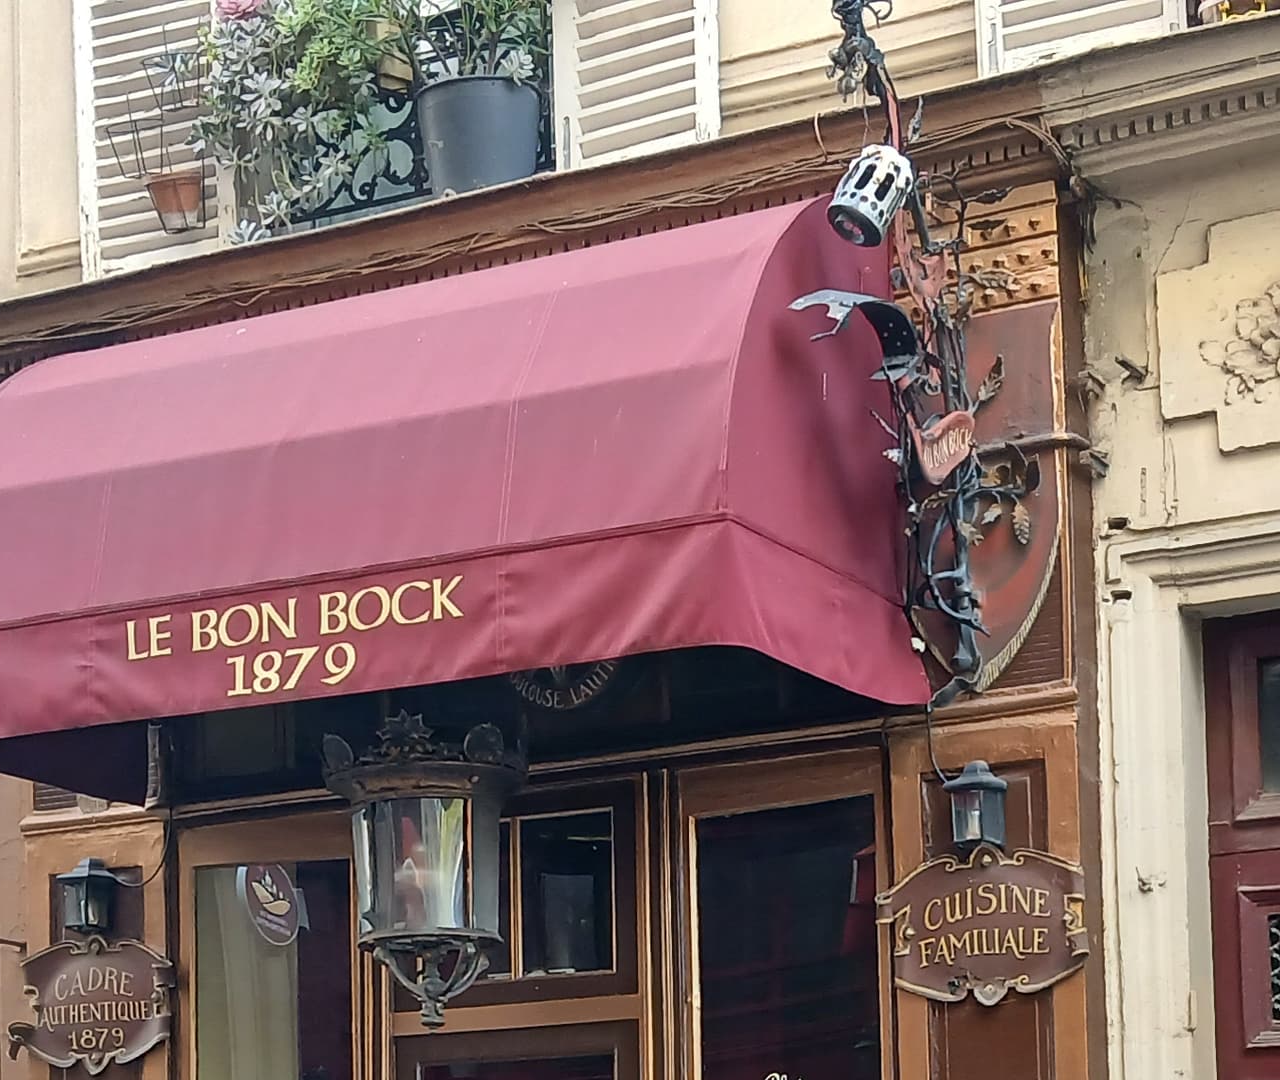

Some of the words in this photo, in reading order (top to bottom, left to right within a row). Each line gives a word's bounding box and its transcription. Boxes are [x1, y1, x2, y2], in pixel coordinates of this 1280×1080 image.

[126, 613, 172, 661] LE
[191, 597, 298, 653] BON
[319, 575, 465, 636] BOCK
[225, 642, 358, 698] 1879
[923, 883, 1051, 931] CUISINE
[918, 927, 1050, 968] FAMILIALE
[54, 966, 134, 1001] CADRE
[37, 1000, 154, 1032] AUTHENTIQUE
[68, 1027, 124, 1050] 1879
